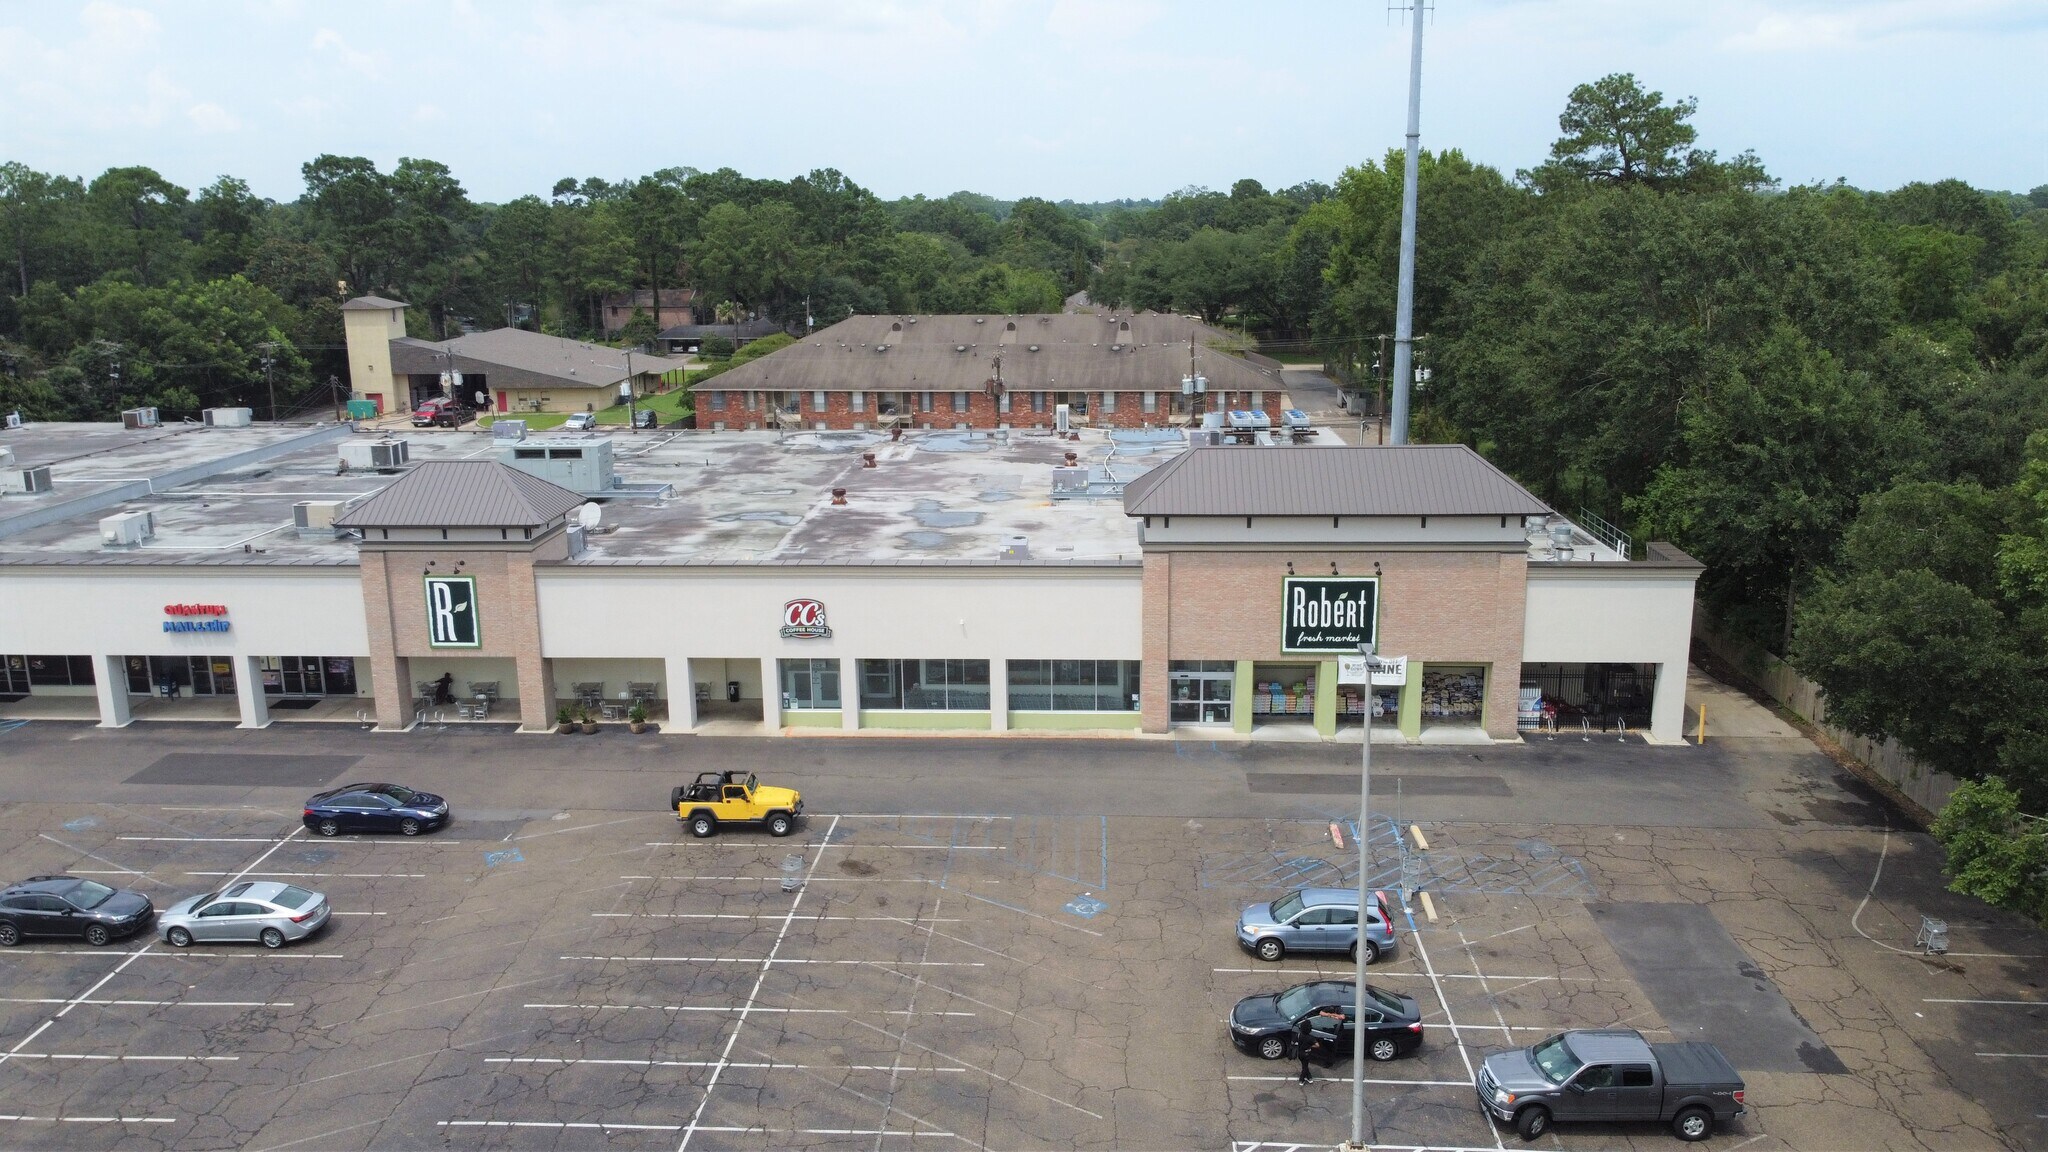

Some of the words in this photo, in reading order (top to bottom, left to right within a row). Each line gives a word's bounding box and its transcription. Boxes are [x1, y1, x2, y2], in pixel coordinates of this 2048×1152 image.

[433, 582, 458, 642] R
[784, 603, 825, 626] CC's
[1297, 632, 1323, 646] fresh
[1325, 632, 1360, 642] market
